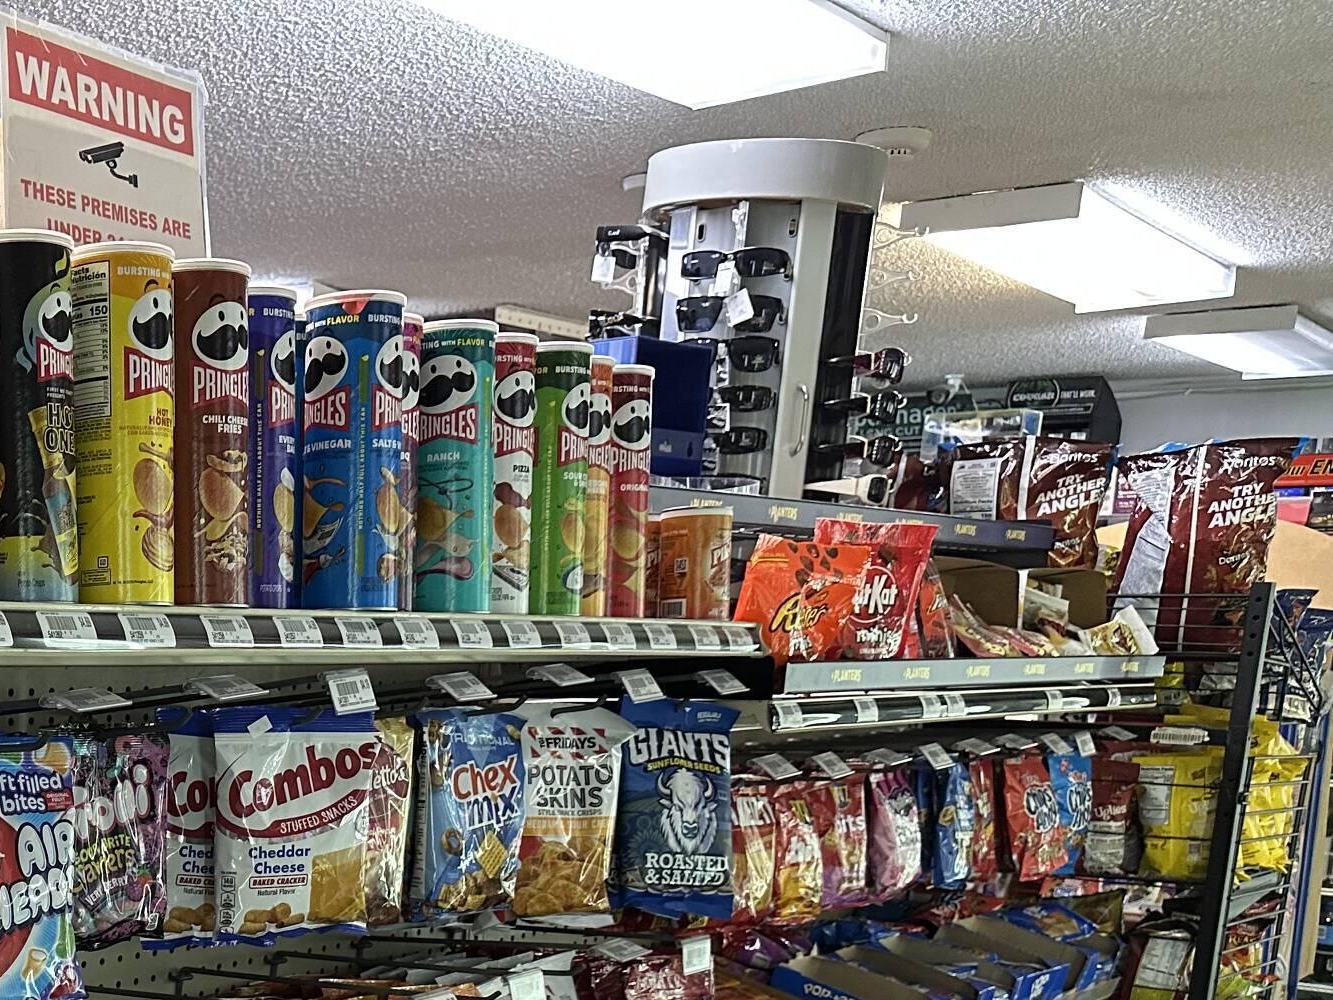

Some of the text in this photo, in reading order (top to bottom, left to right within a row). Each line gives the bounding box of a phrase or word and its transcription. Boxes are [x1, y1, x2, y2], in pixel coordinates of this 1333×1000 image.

[16, 51, 186, 145] WARNING
[20, 178, 191, 240] THESE PREMISES ARE
[117, 265, 162, 278] BURSTING
[89, 306, 108, 316] 150
[326, 313, 361, 326] FLAVOR
[456, 337, 485, 347] FLAVOR
[156, 407, 169, 417] HOT
[202, 414, 225, 425] CHILI
[217, 422, 243, 434] FRIES
[310, 438, 352, 450] VINEGAR
[372, 438, 392, 448] SALT
[426, 451, 461, 462] RANCH
[512, 463, 530, 474] PIZZA
[1056, 473, 1083, 485] TRY
[1035, 478, 1106, 505] ANOTHER
[1232, 482, 1265, 498] TRY
[545, 736, 597, 750] FRIDAYS
[628, 728, 731, 766] GIANTS
[16, 772, 63, 792] filled
[228, 742, 377, 819] Combos
[451, 755, 518, 801] Chex
[527, 763, 613, 786] POTATO
[2, 793, 46, 814] bites
[536, 786, 604, 809] SKINS
[279, 795, 359, 836] STUFFED SNACKS
[248, 844, 312, 860] Cheddar
[253, 861, 305, 875] Cheese
[645, 852, 729, 872] ROASTED
[251, 876, 306, 888] BAKED CRACKER
[661, 867, 725, 886] SALTED
